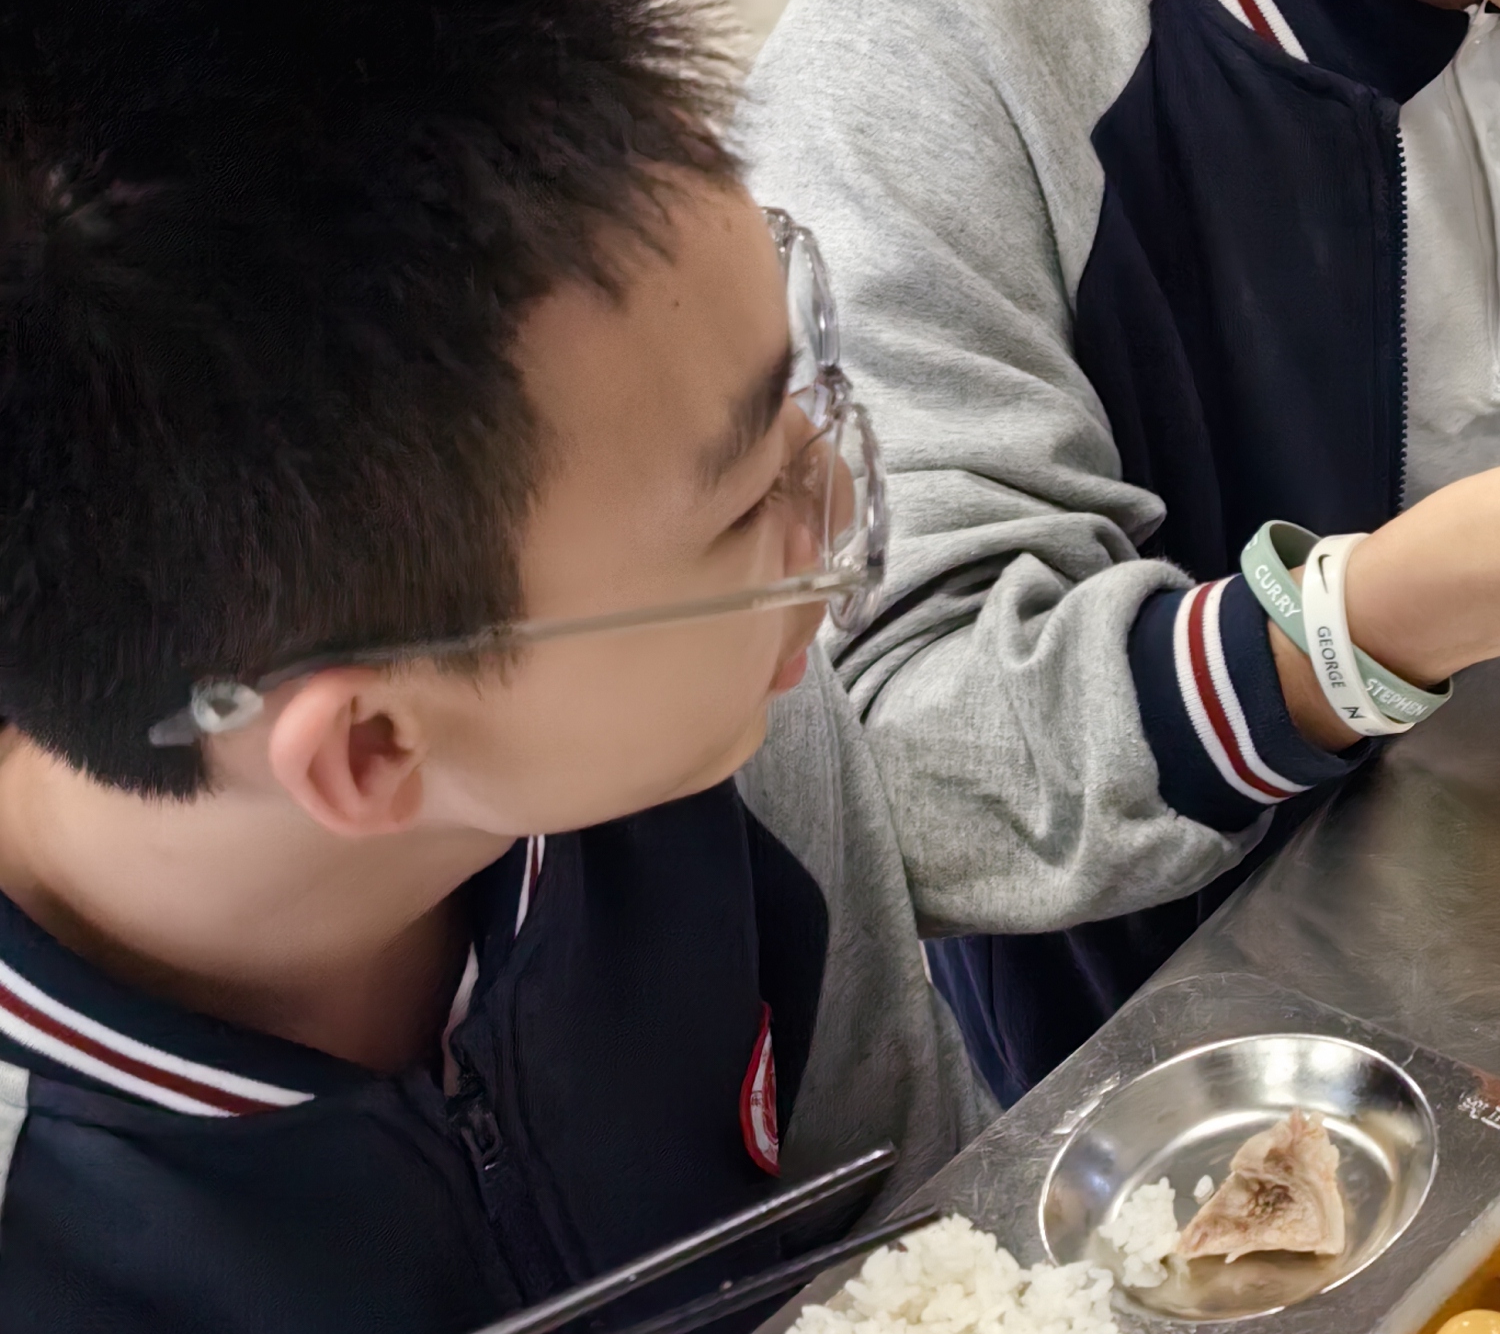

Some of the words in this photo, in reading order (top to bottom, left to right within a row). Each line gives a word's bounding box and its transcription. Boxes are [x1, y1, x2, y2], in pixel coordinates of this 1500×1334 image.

[1254, 564, 1302, 617] CURRY
[1317, 625, 1347, 689] GEORGE
[1364, 677, 1429, 717] STEPHEN
